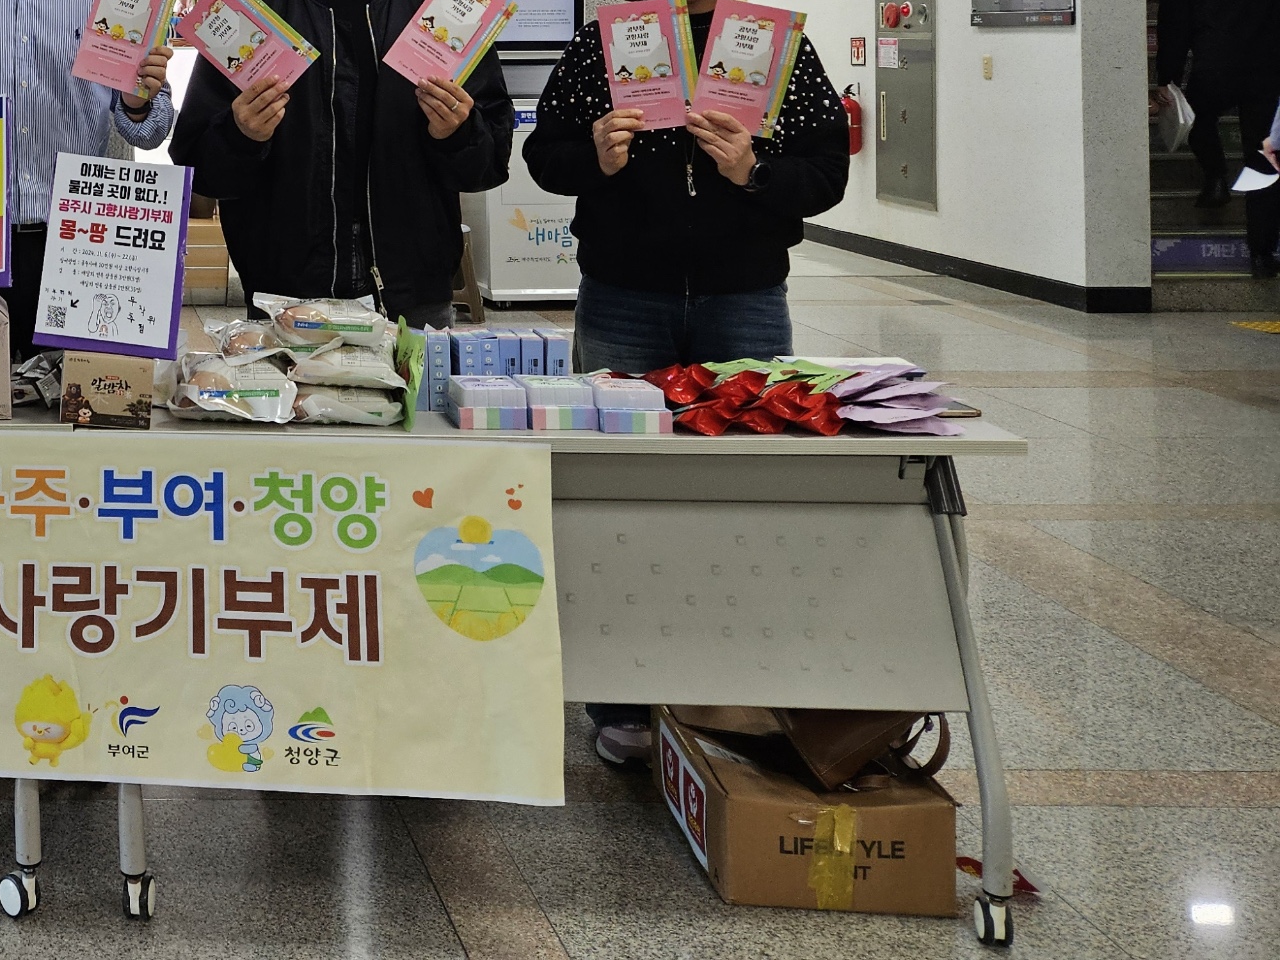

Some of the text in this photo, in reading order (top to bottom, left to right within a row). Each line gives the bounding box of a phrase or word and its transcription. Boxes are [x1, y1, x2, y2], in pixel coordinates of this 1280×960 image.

[80, 162, 158, 184] 이제는 더 이상
[68, 180, 168, 205] 물러설 곳이 없다.!
[58, 198, 173, 224] 공주시 고향사랑기부제
[59, 219, 166, 251] 몽~땅 드려요
[91, 377, 131, 394] 알밤차
[107, 743, 149, 760] 부여군
[284, 747, 341, 767] 청양군
